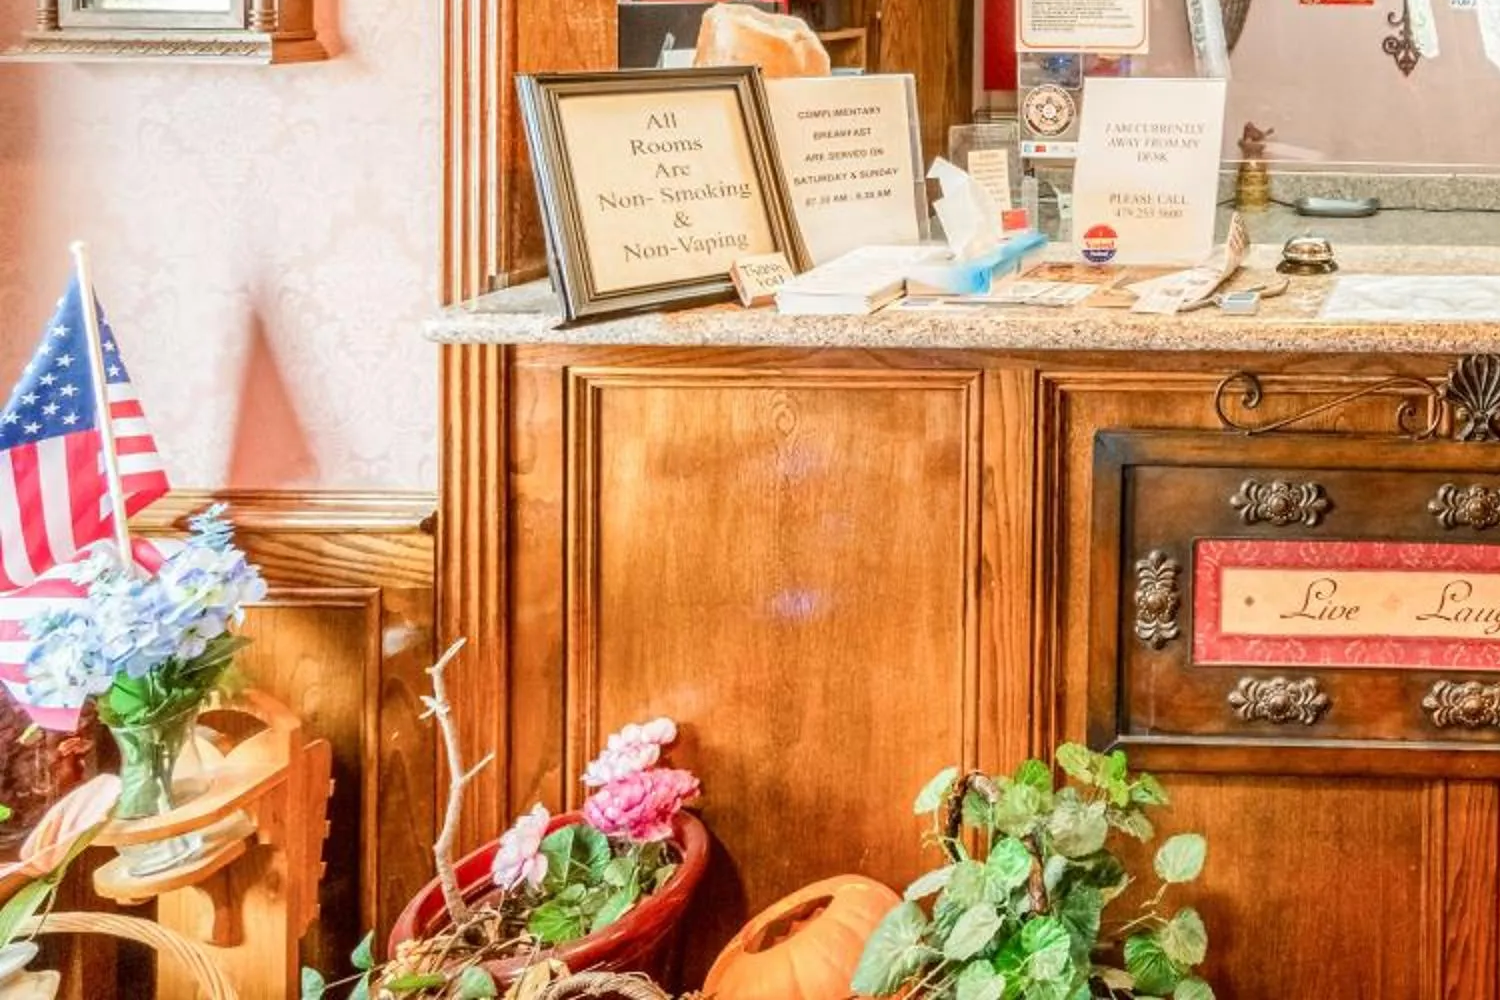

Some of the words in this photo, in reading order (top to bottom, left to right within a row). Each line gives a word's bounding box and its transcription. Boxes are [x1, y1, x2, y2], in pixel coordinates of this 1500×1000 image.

[646, 111, 678, 130] All
[798, 105, 882, 120] COMPLIMENTARY
[812, 127, 872, 141] BREAKFAST
[1134, 122, 1206, 134] CURRENTLY
[629, 136, 705, 156] Rooms
[1107, 137, 1140, 148] AWAY
[1144, 138, 1179, 148] FROM
[805, 152, 825, 163] ARE
[827, 149, 868, 161] SERVED
[655, 163, 691, 179] Are
[793, 172, 848, 186] SATURDAY
[849, 172, 857, 180] &
[859, 167, 898, 179] SUNDAY
[598, 192, 654, 212] Non-
[659, 182, 752, 204] Smoking
[1109, 192, 1153, 204] PLEASE
[1157, 192, 1190, 205] CALL
[673, 211, 692, 229] &
[624, 232, 749, 262] Non-Vaping
[1280, 577, 1361, 621] Live
